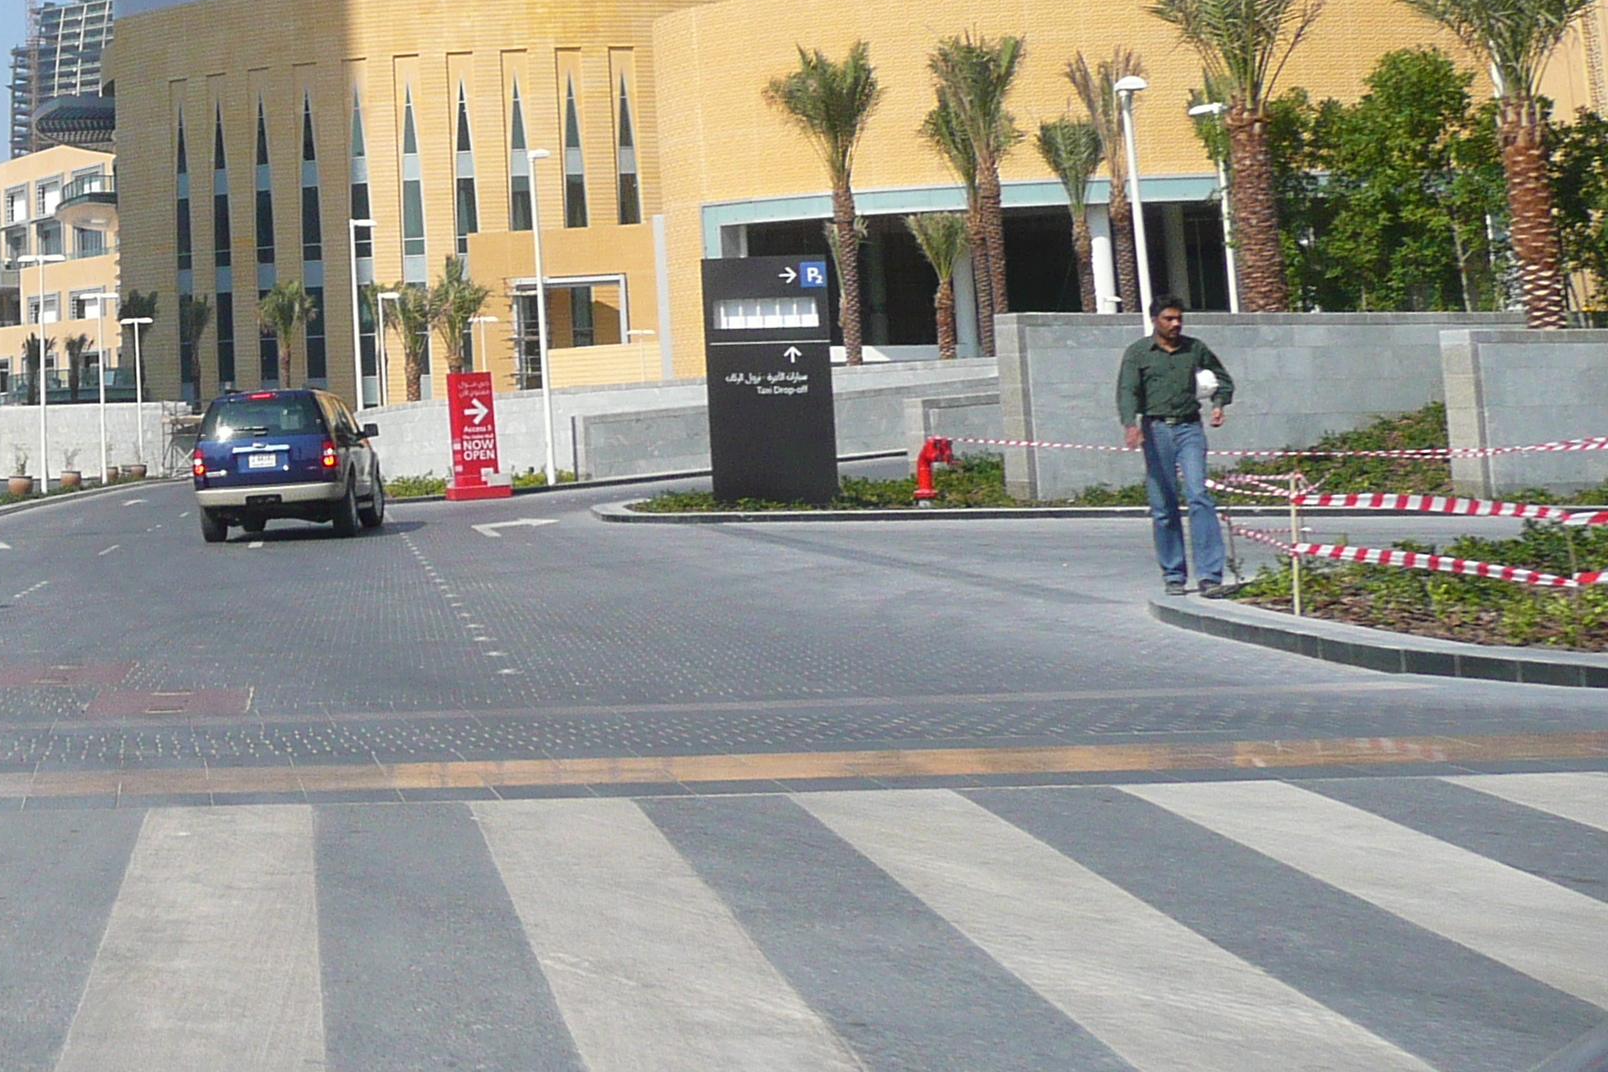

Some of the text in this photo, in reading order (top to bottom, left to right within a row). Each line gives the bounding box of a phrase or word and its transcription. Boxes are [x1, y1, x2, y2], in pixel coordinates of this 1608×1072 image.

[757, 385, 808, 395] Taxi Drop-off
[463, 439, 494, 450] NOW
[464, 449, 495, 461] OPEN
